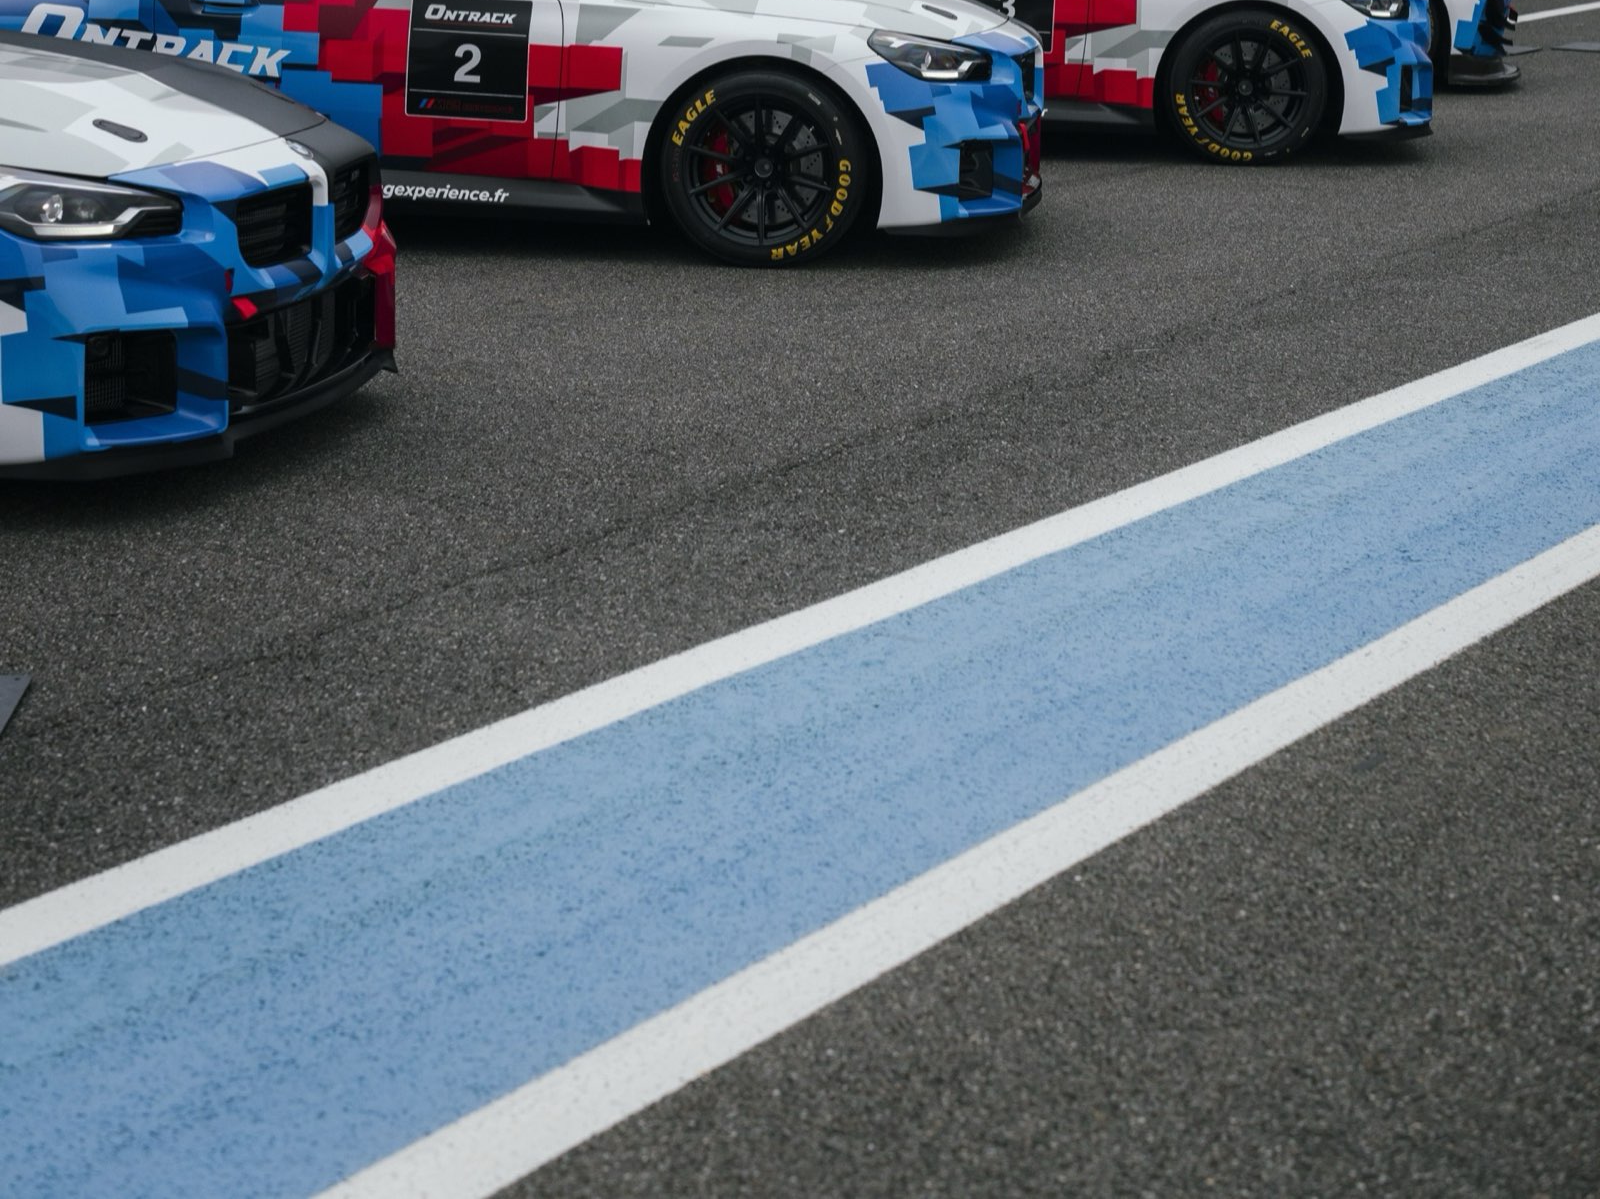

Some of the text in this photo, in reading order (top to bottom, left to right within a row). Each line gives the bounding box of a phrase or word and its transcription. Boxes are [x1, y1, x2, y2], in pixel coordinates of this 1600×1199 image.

[425, 4, 516, 24] ONTRACK
[1270, 19, 1312, 58] EAGLE
[454, 43, 481, 83] 2
[671, 89, 716, 146] EAGLE
[382, 184, 508, 202] gexperience.fr
